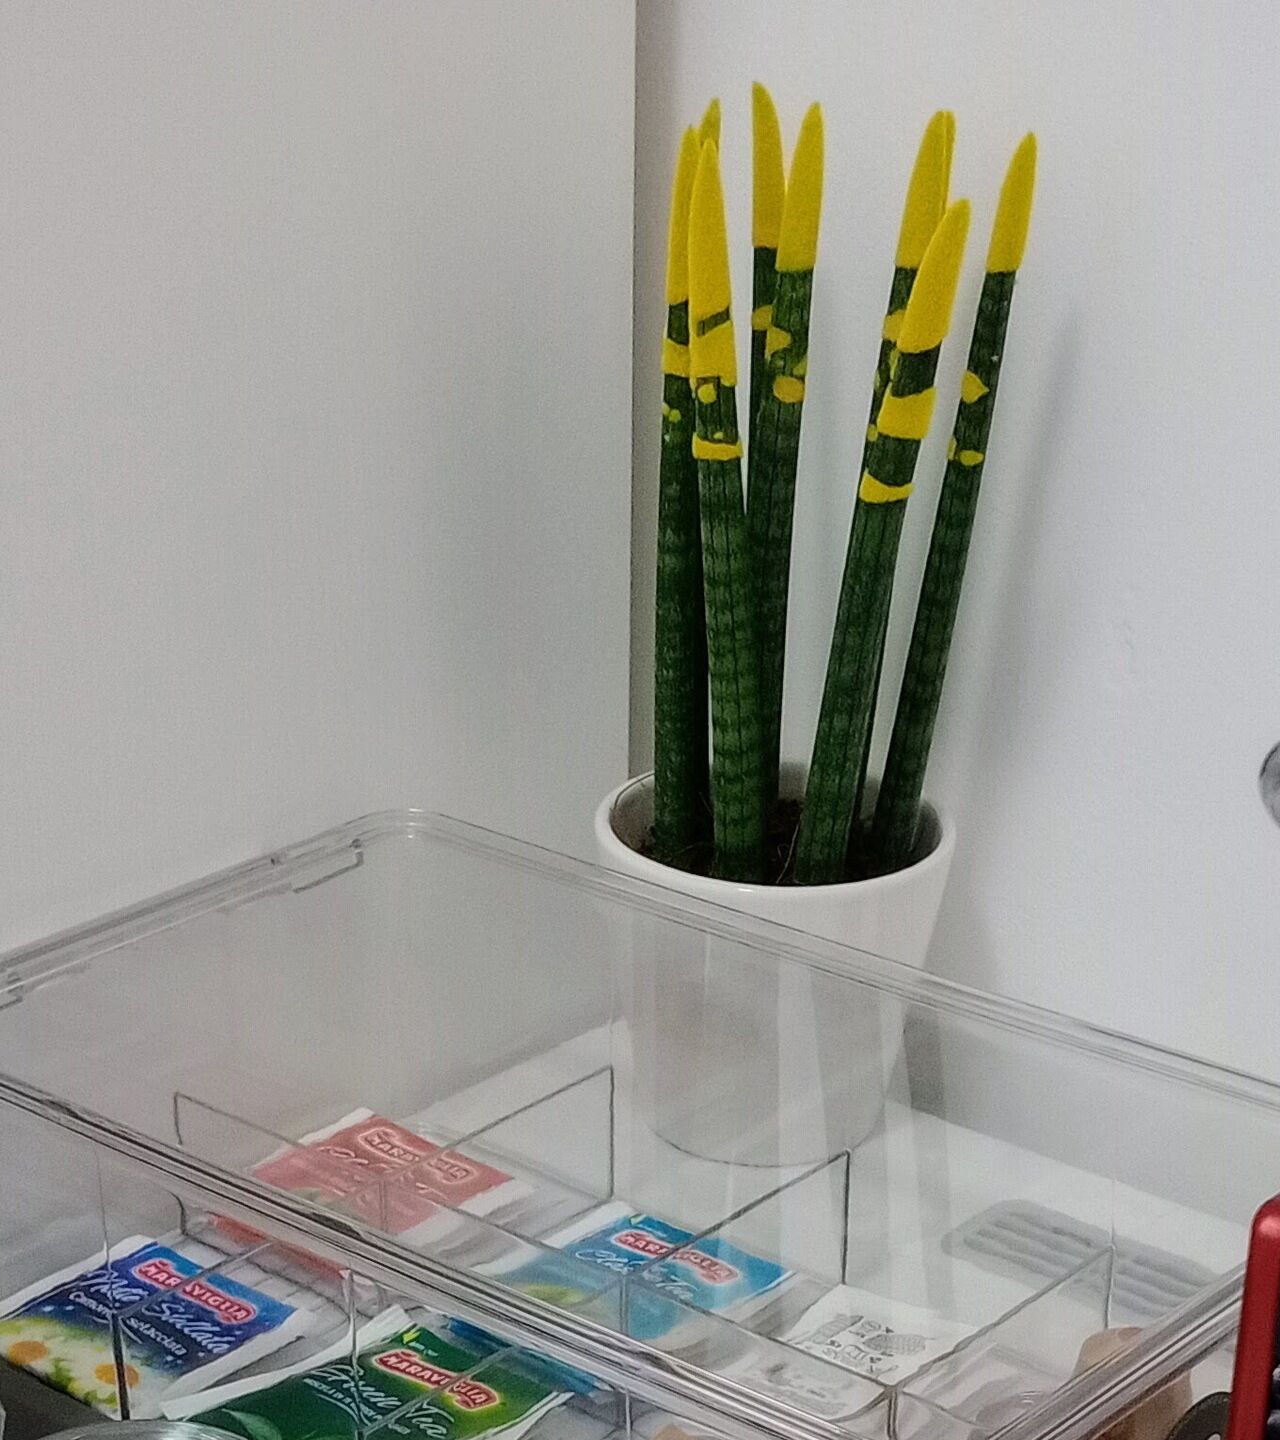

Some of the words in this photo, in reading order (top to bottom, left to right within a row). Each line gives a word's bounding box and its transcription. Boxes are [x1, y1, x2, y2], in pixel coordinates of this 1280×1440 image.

[310, 1364, 402, 1409] Green
[406, 1400, 456, 1440] Tea
[382, 1355, 490, 1405] MARAVIGLIA
